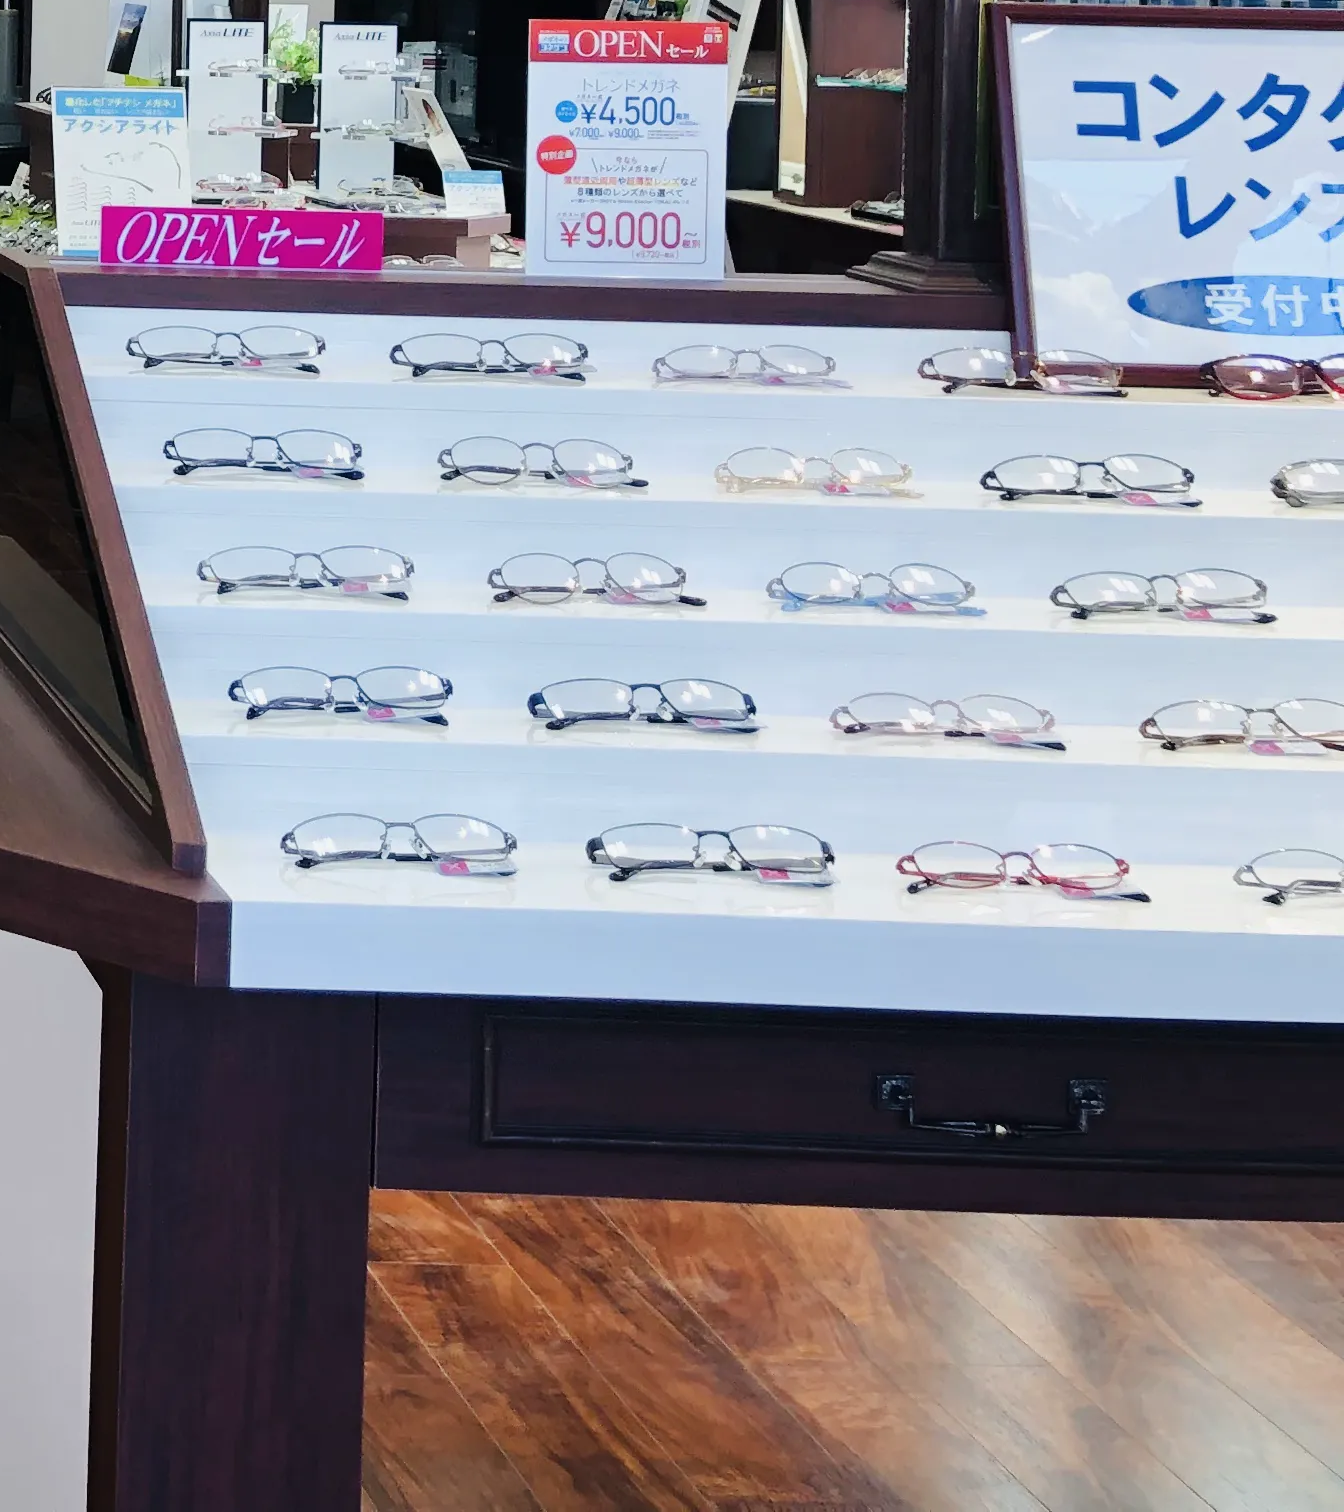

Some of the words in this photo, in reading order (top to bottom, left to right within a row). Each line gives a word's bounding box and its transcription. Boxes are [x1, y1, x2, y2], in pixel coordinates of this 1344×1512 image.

[223, 28, 255, 37] LITE
[356, 31, 387, 41] LITE
[582, 78, 680, 93] トレンドメガネ
[581, 96, 675, 126] ¥4,500
[63, 118, 180, 135] アクシアライト
